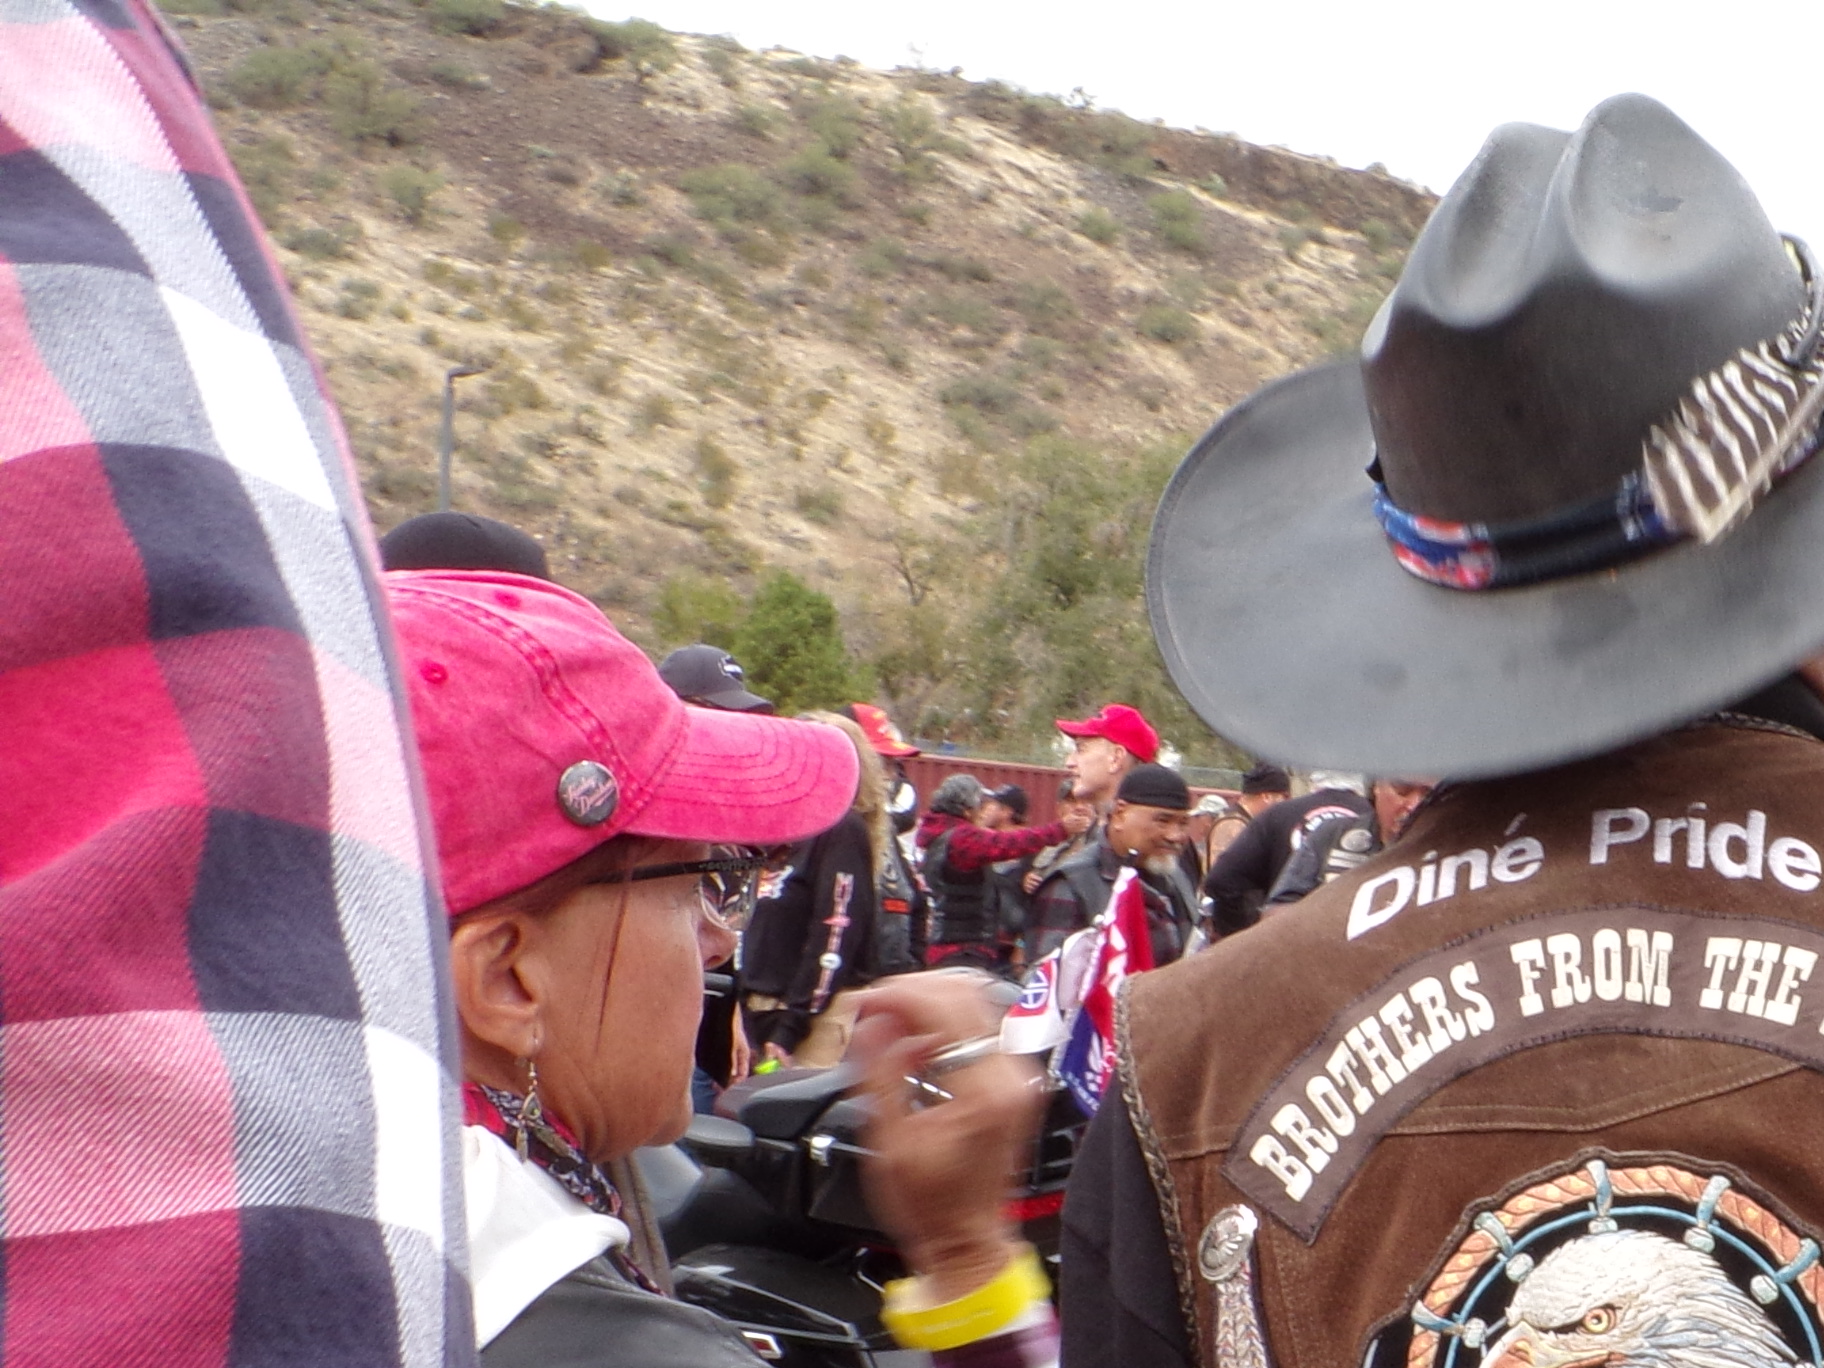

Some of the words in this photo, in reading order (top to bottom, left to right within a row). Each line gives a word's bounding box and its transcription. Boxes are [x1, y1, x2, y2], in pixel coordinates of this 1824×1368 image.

[1346, 812, 1545, 941] Diné
[1589, 802, 1823, 892] Pride
[1250, 961, 1496, 1203] BROTHERS
[1509, 927, 1674, 1018] FROM
[1699, 935, 1818, 1027] THE
